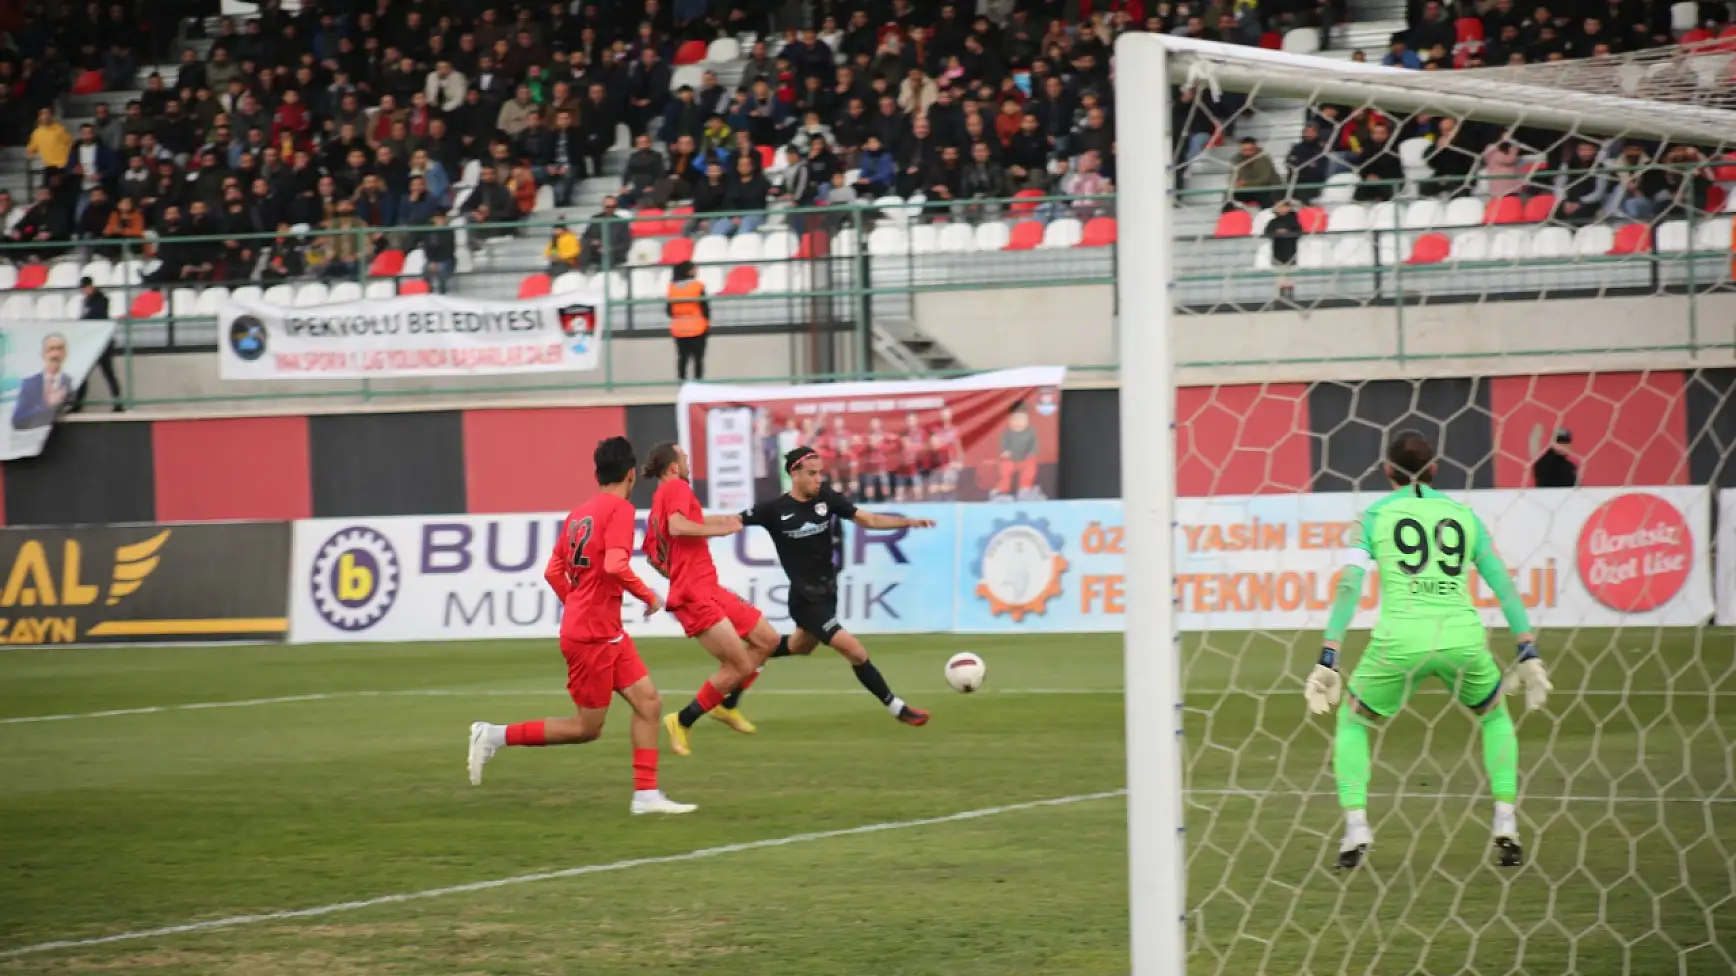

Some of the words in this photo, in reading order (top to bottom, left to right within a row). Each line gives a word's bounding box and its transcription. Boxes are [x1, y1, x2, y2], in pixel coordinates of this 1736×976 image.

[1182, 516, 1287, 552] YASİN
[1394, 518, 1465, 576] 99
[1589, 556, 1638, 585] Özel
[1643, 551, 1685, 576] Lise
